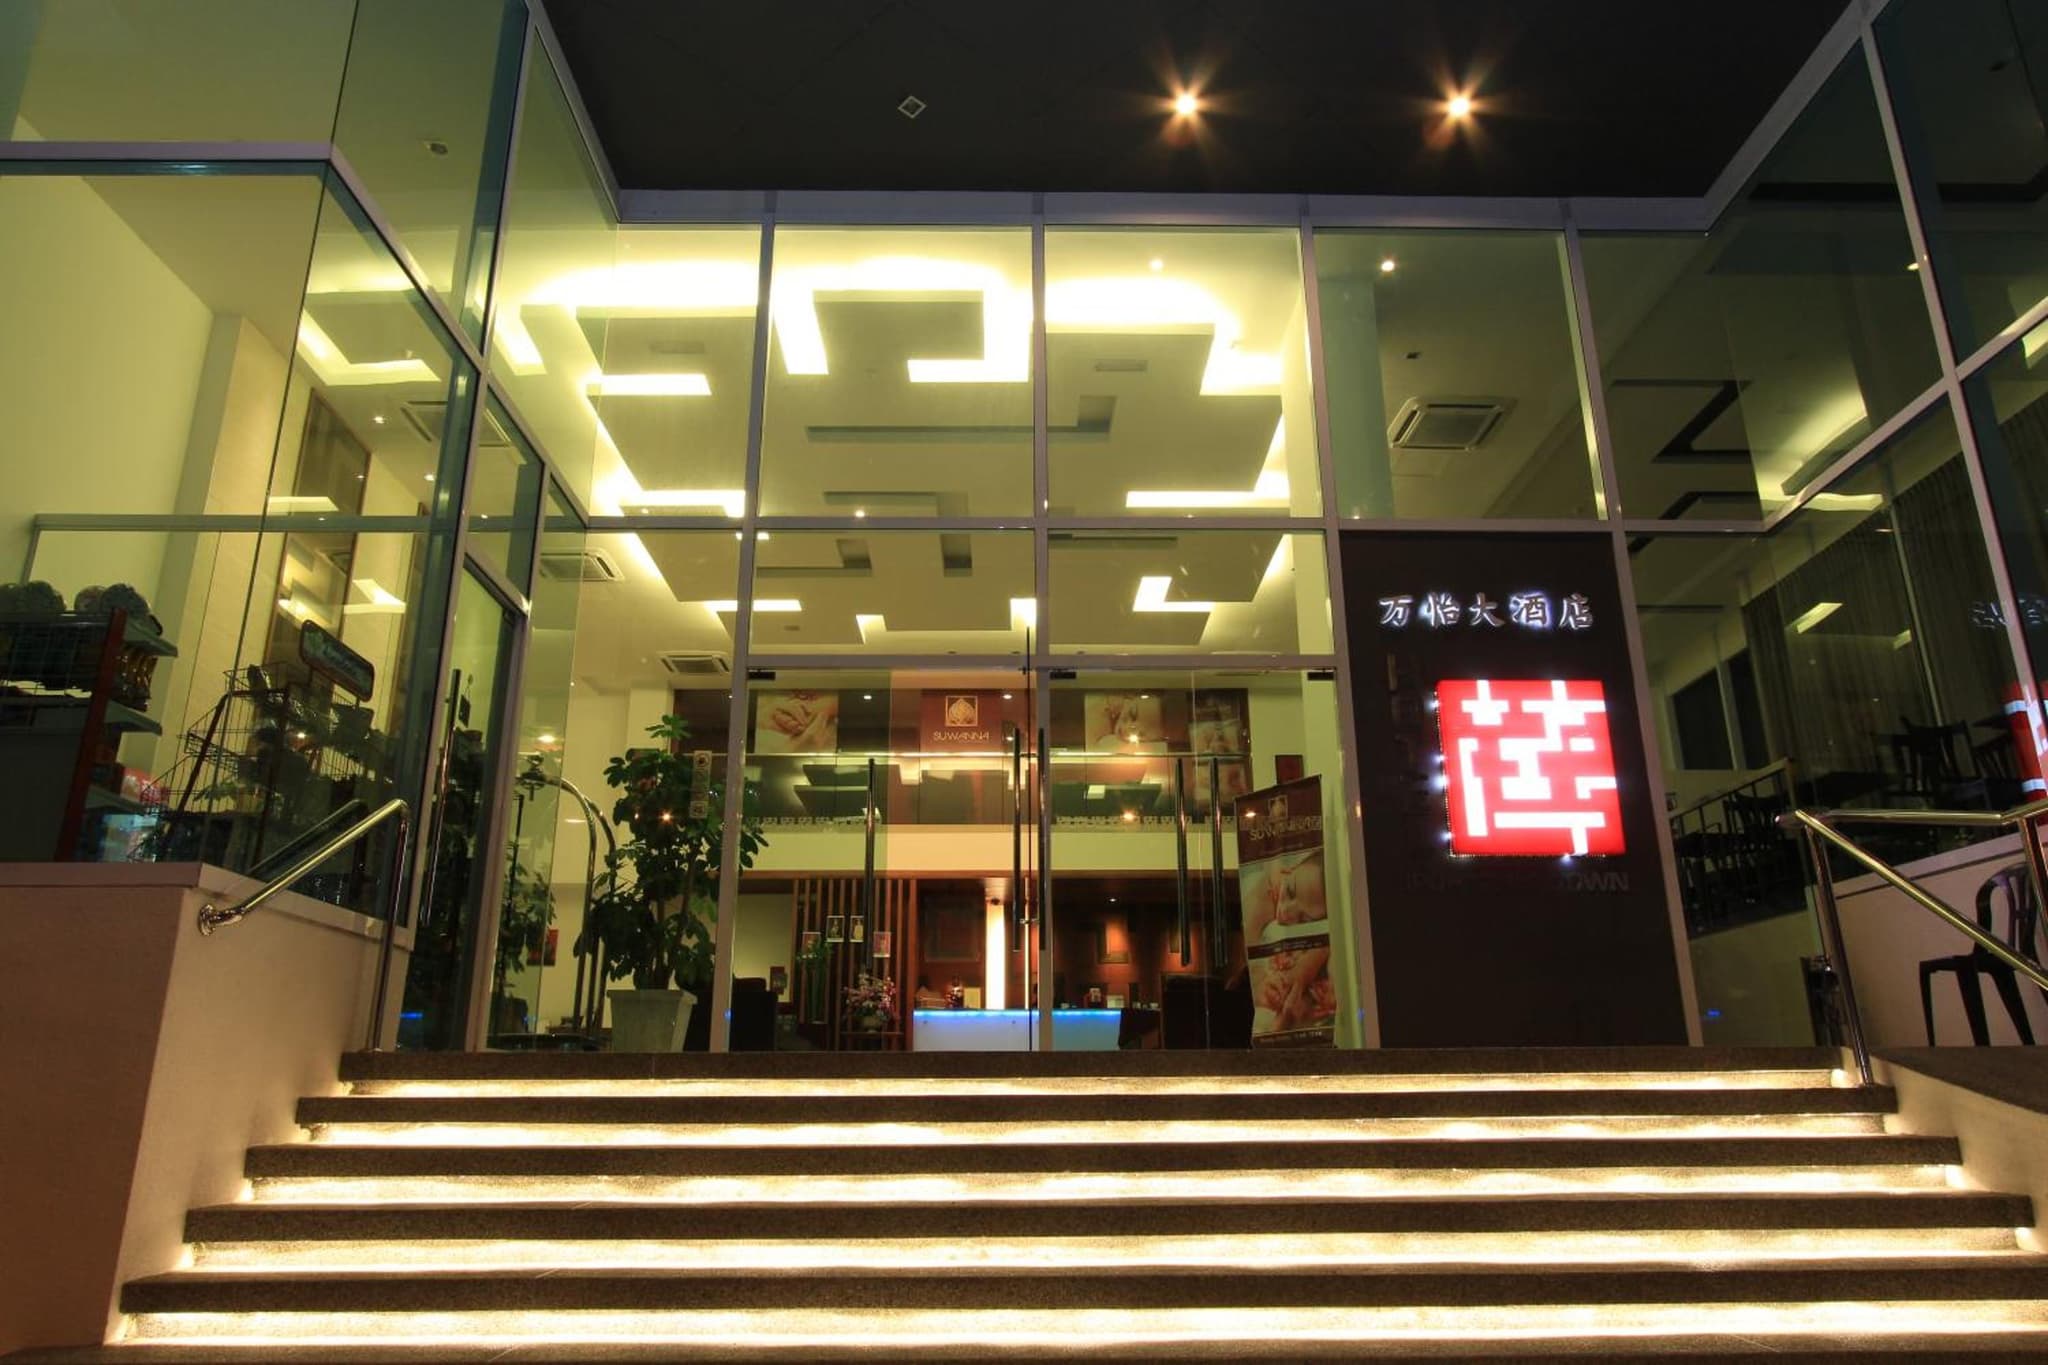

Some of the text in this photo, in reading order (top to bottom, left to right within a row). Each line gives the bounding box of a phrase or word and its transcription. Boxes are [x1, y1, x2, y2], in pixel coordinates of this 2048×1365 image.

[1379, 592, 1594, 630] 万怡大酒店
[933, 730, 990, 742] SUWANNA
